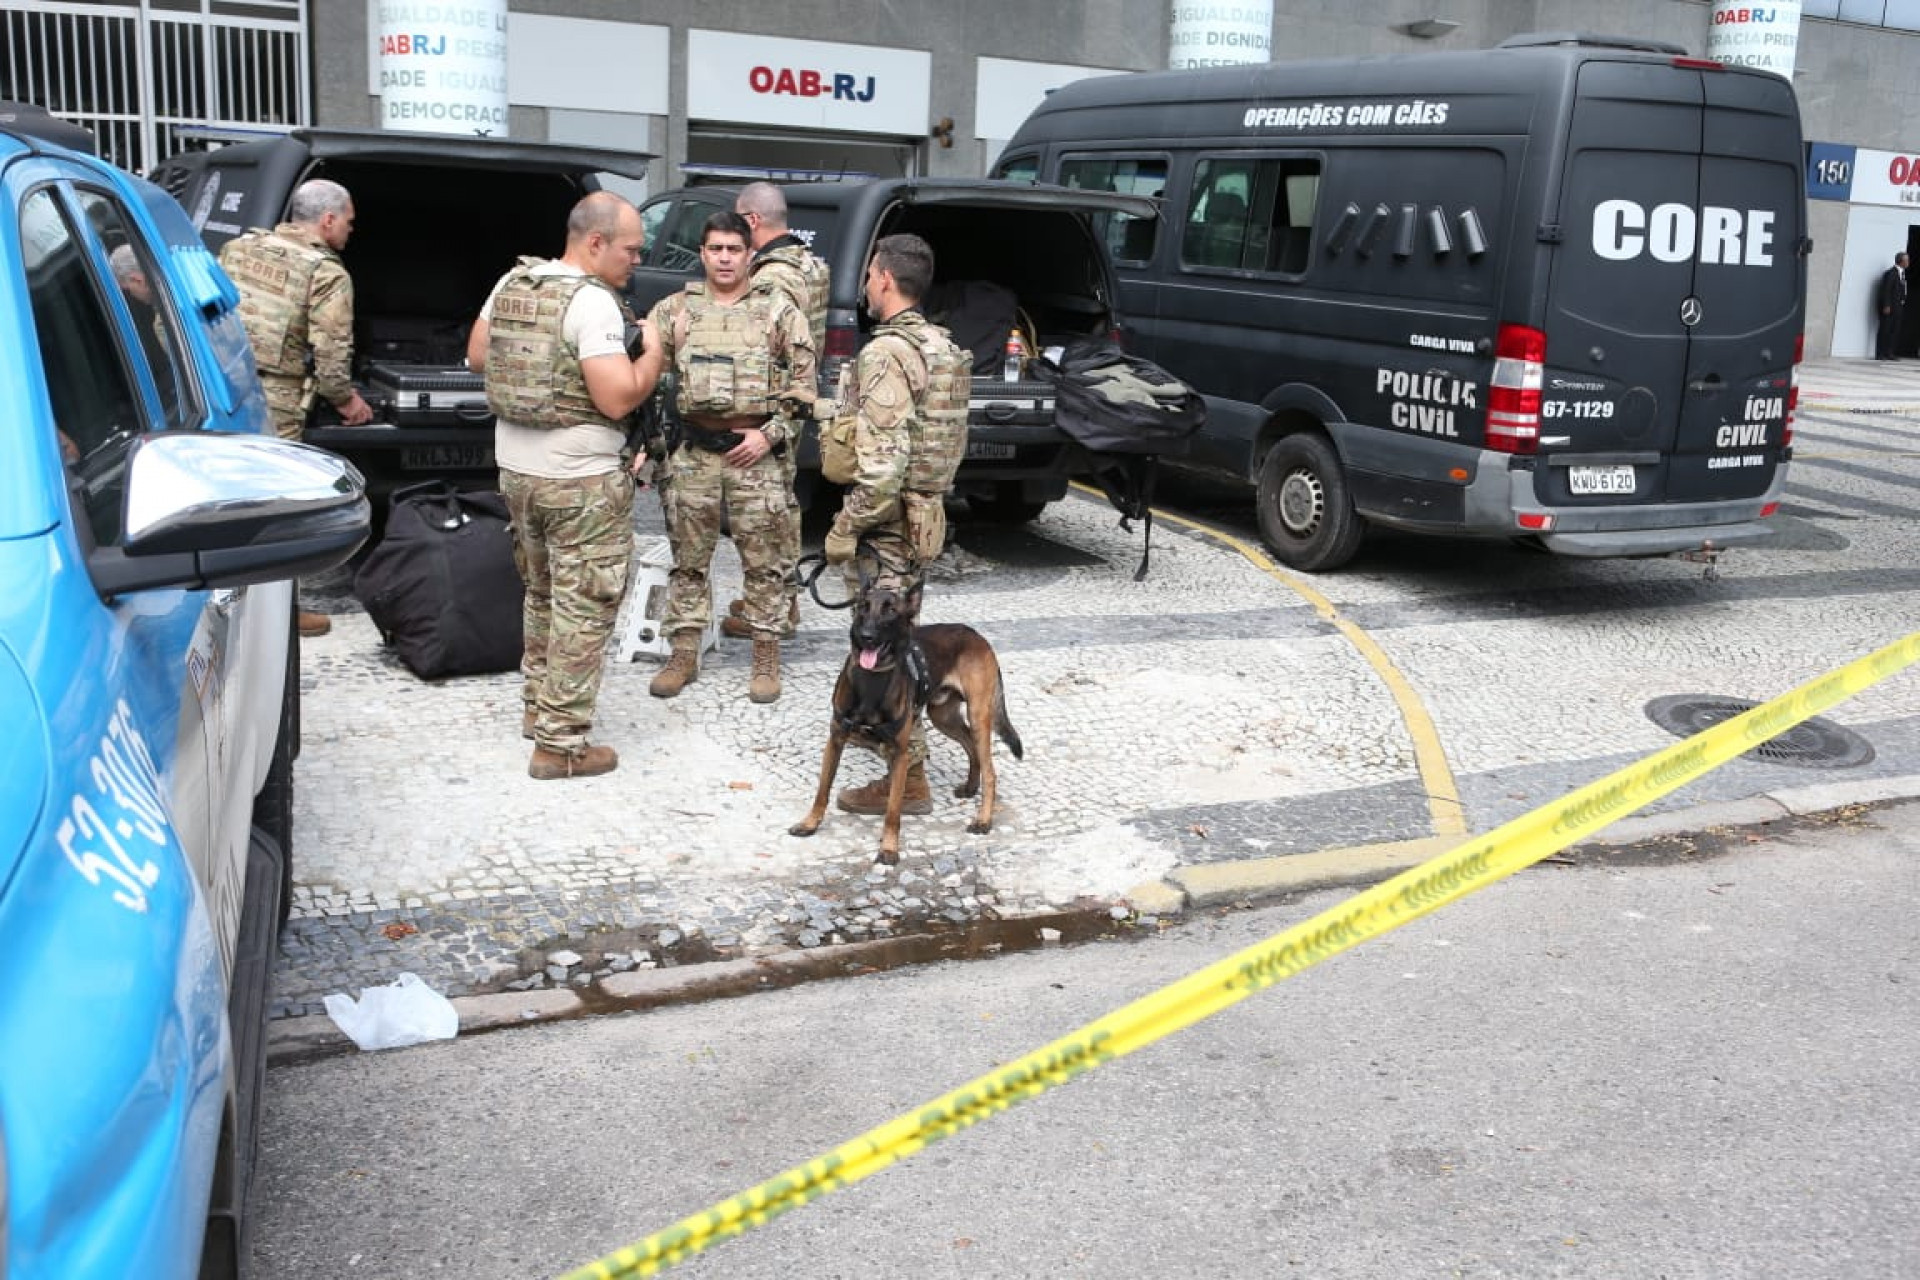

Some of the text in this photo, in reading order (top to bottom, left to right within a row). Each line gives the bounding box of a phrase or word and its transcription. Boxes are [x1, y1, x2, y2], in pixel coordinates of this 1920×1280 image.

[1715, 8, 1776, 25] OABRJ
[749, 66, 875, 103] OAB-RJ
[1244, 100, 1449, 130] OPERAÇÕES COM CÃES
[1817, 159, 1849, 184] 150
[1592, 199, 1775, 267] CORE
[1410, 334, 1475, 353] CARGA VIVA
[1391, 401, 1459, 437] CIVIL
[1542, 400, 1615, 418] 67-1129
[1716, 424, 1768, 447] CIVIL
